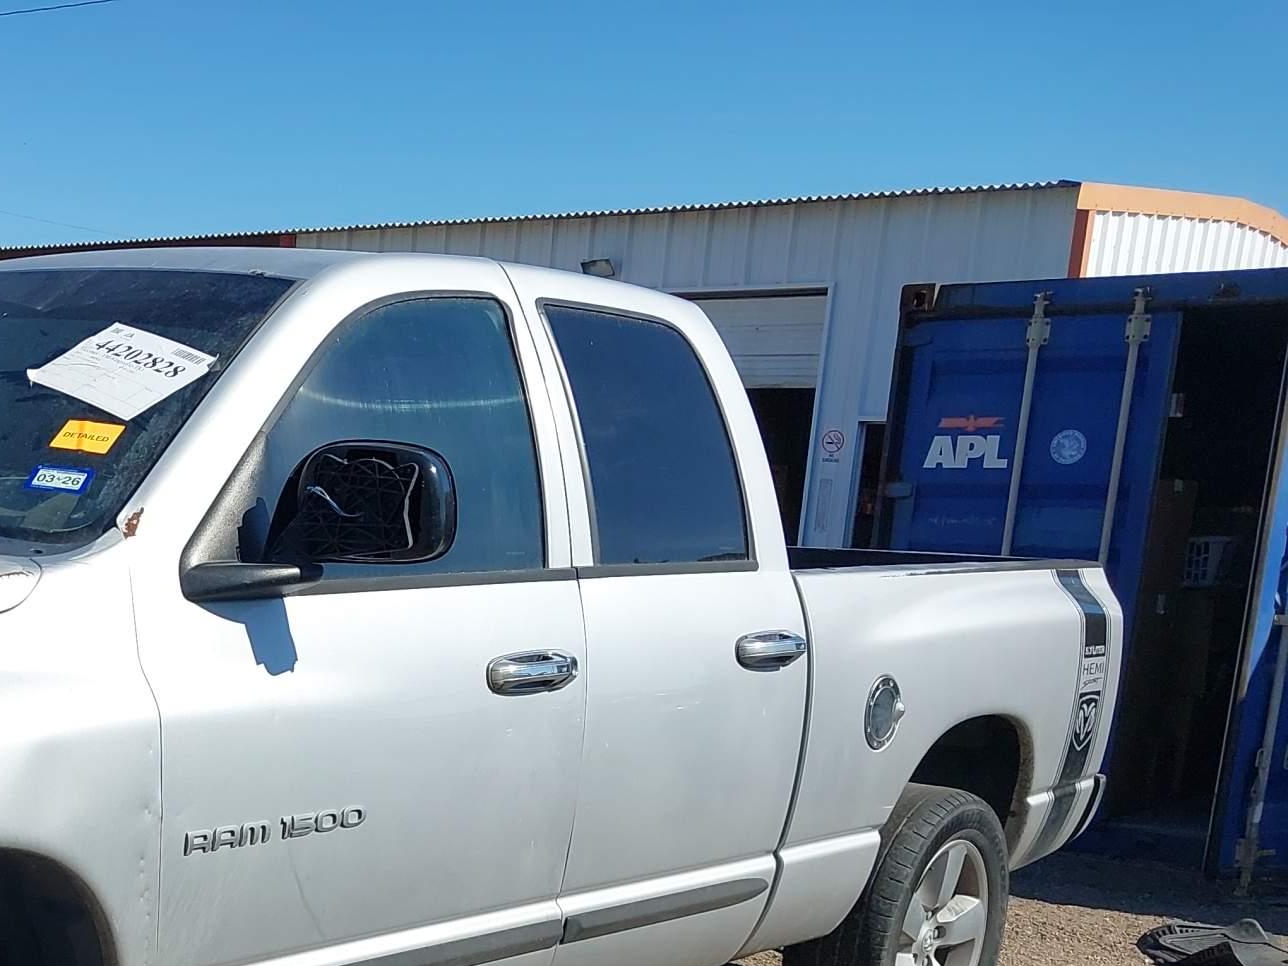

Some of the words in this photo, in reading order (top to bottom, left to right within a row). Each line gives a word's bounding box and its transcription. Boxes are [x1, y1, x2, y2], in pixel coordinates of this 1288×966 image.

[95, 339, 186, 378] 44202828
[62, 430, 110, 442] DETAILED
[922, 434, 1009, 469] APL
[36, 473, 56, 484] 03
[62, 476, 82, 486] 26
[1082, 660, 1104, 676] HEMI
[183, 819, 272, 857] RAM
[279, 803, 367, 841] 1500
